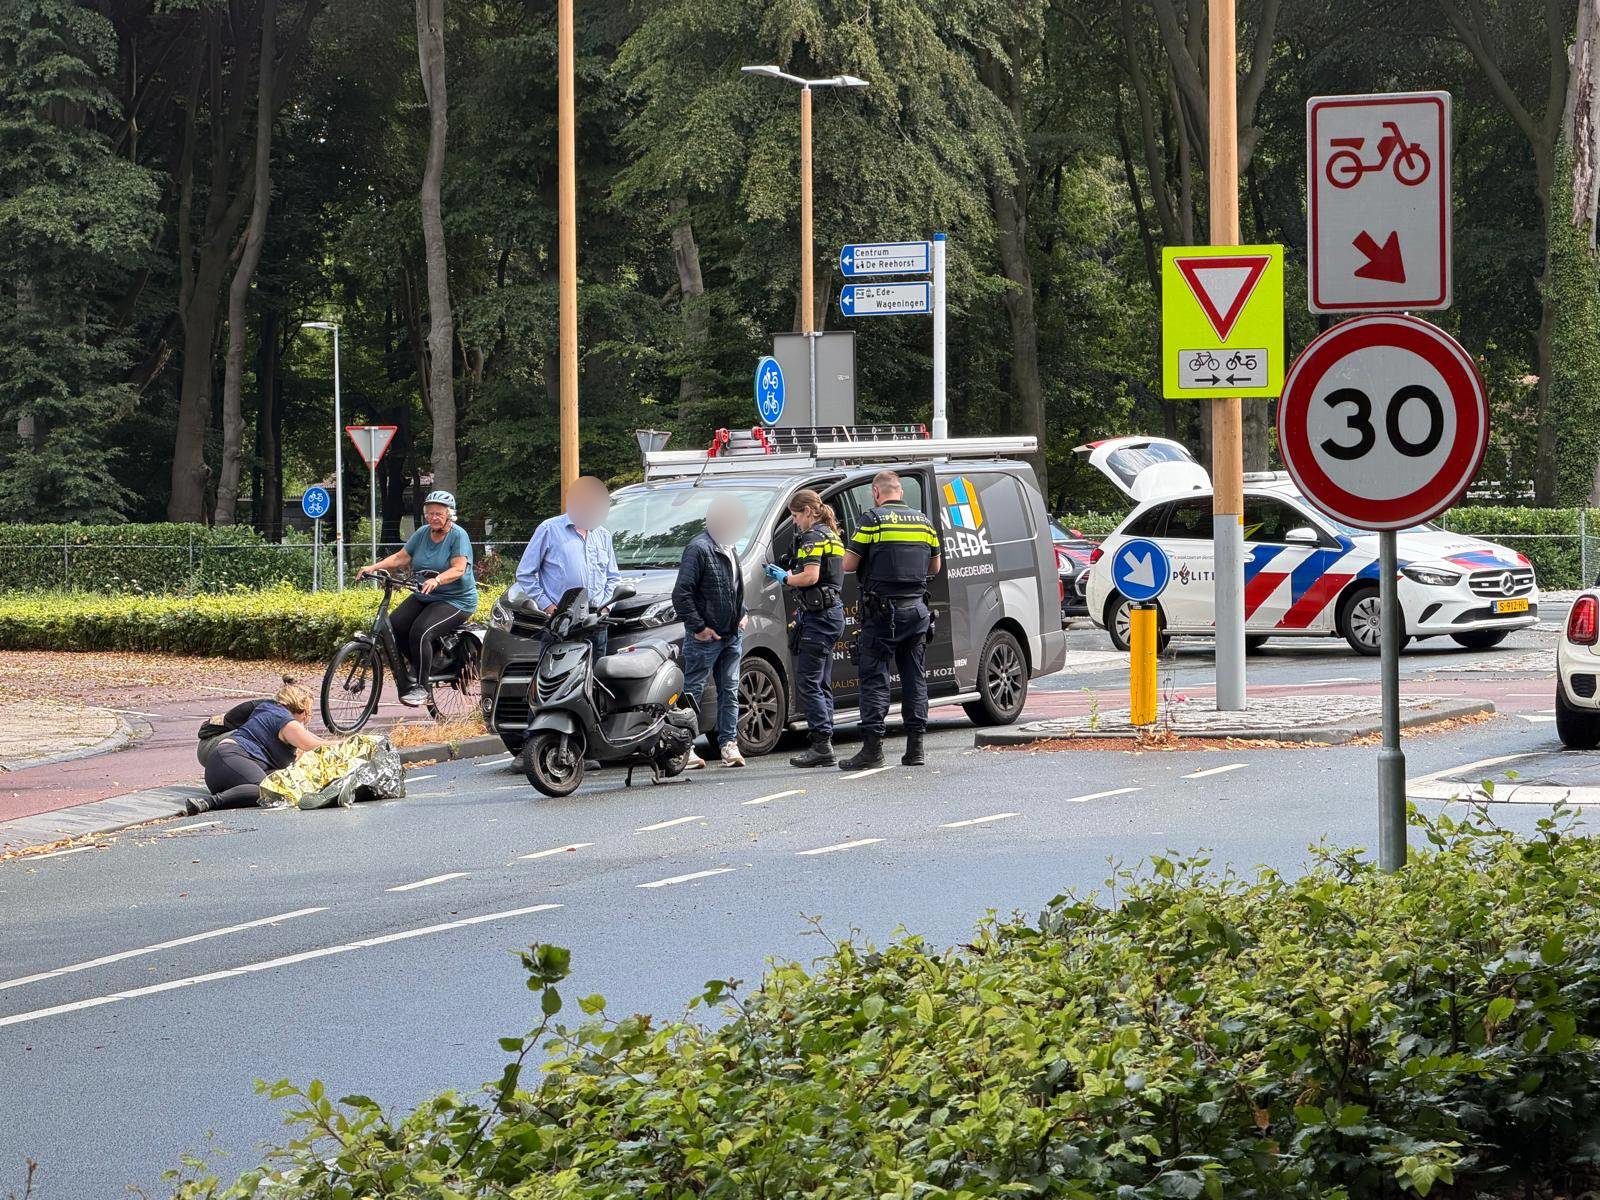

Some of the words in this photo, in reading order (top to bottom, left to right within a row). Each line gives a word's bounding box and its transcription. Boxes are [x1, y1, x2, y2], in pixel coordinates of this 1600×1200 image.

[855, 248, 889, 257] Centrum
[866, 261, 876, 269] De
[879, 259, 915, 268] Reehorst
[876, 288, 895, 296] Ede-
[876, 300, 925, 309] Wageningen
[1320, 384, 1444, 461] 30
